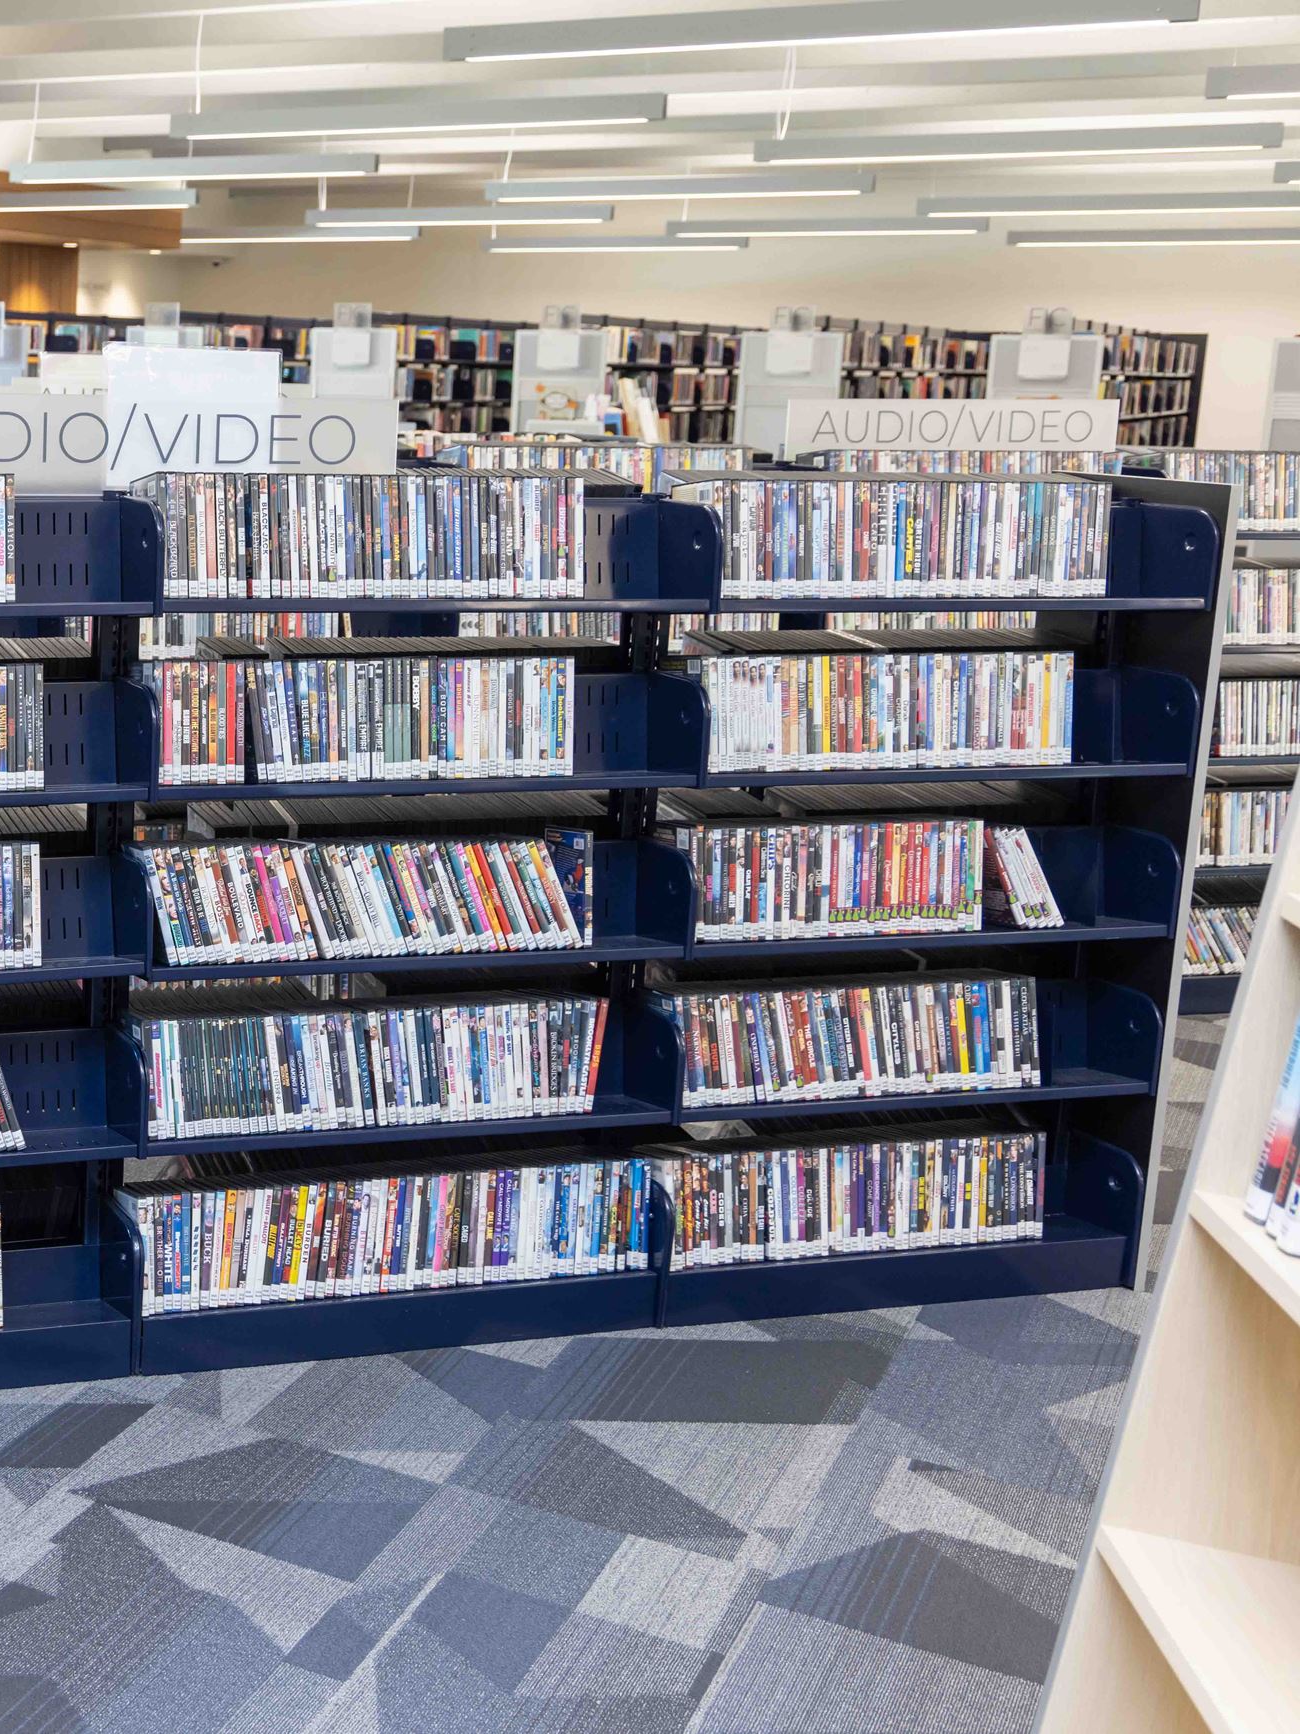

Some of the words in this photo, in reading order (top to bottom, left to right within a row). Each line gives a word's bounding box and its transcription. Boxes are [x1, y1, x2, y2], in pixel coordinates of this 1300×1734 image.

[811, 404, 1094, 447] AUDIO/VIDEO
[217, 497, 226, 527] BLACK
[300, 506, 308, 567] BLACKLIGHT
[218, 528, 227, 578] BUTTERFLY
[412, 675, 420, 711] BOBBY
[439, 694, 447, 720] BODY
[300, 699, 310, 719] BLUE
[301, 720, 310, 737] LIKE
[439, 722, 447, 741] CAM
[302, 738, 311, 758] JAZZ
[768, 834, 776, 870] CHIPS
[227, 882, 243, 929] BOULEVARD
[246, 882, 258, 912] BOUNCE
[459, 878, 477, 915] BREACH
[251, 912, 262, 934] BACK
[358, 1043, 368, 1069] BRIAN
[807, 1041, 815, 1068] CIRCLE
[361, 1071, 370, 1098] BANKS
[203, 1232, 213, 1264] BUCK
[302, 1223, 312, 1264] BURDEN
[320, 1219, 332, 1262] BURIED
[164, 1243, 174, 1283] WHITE
